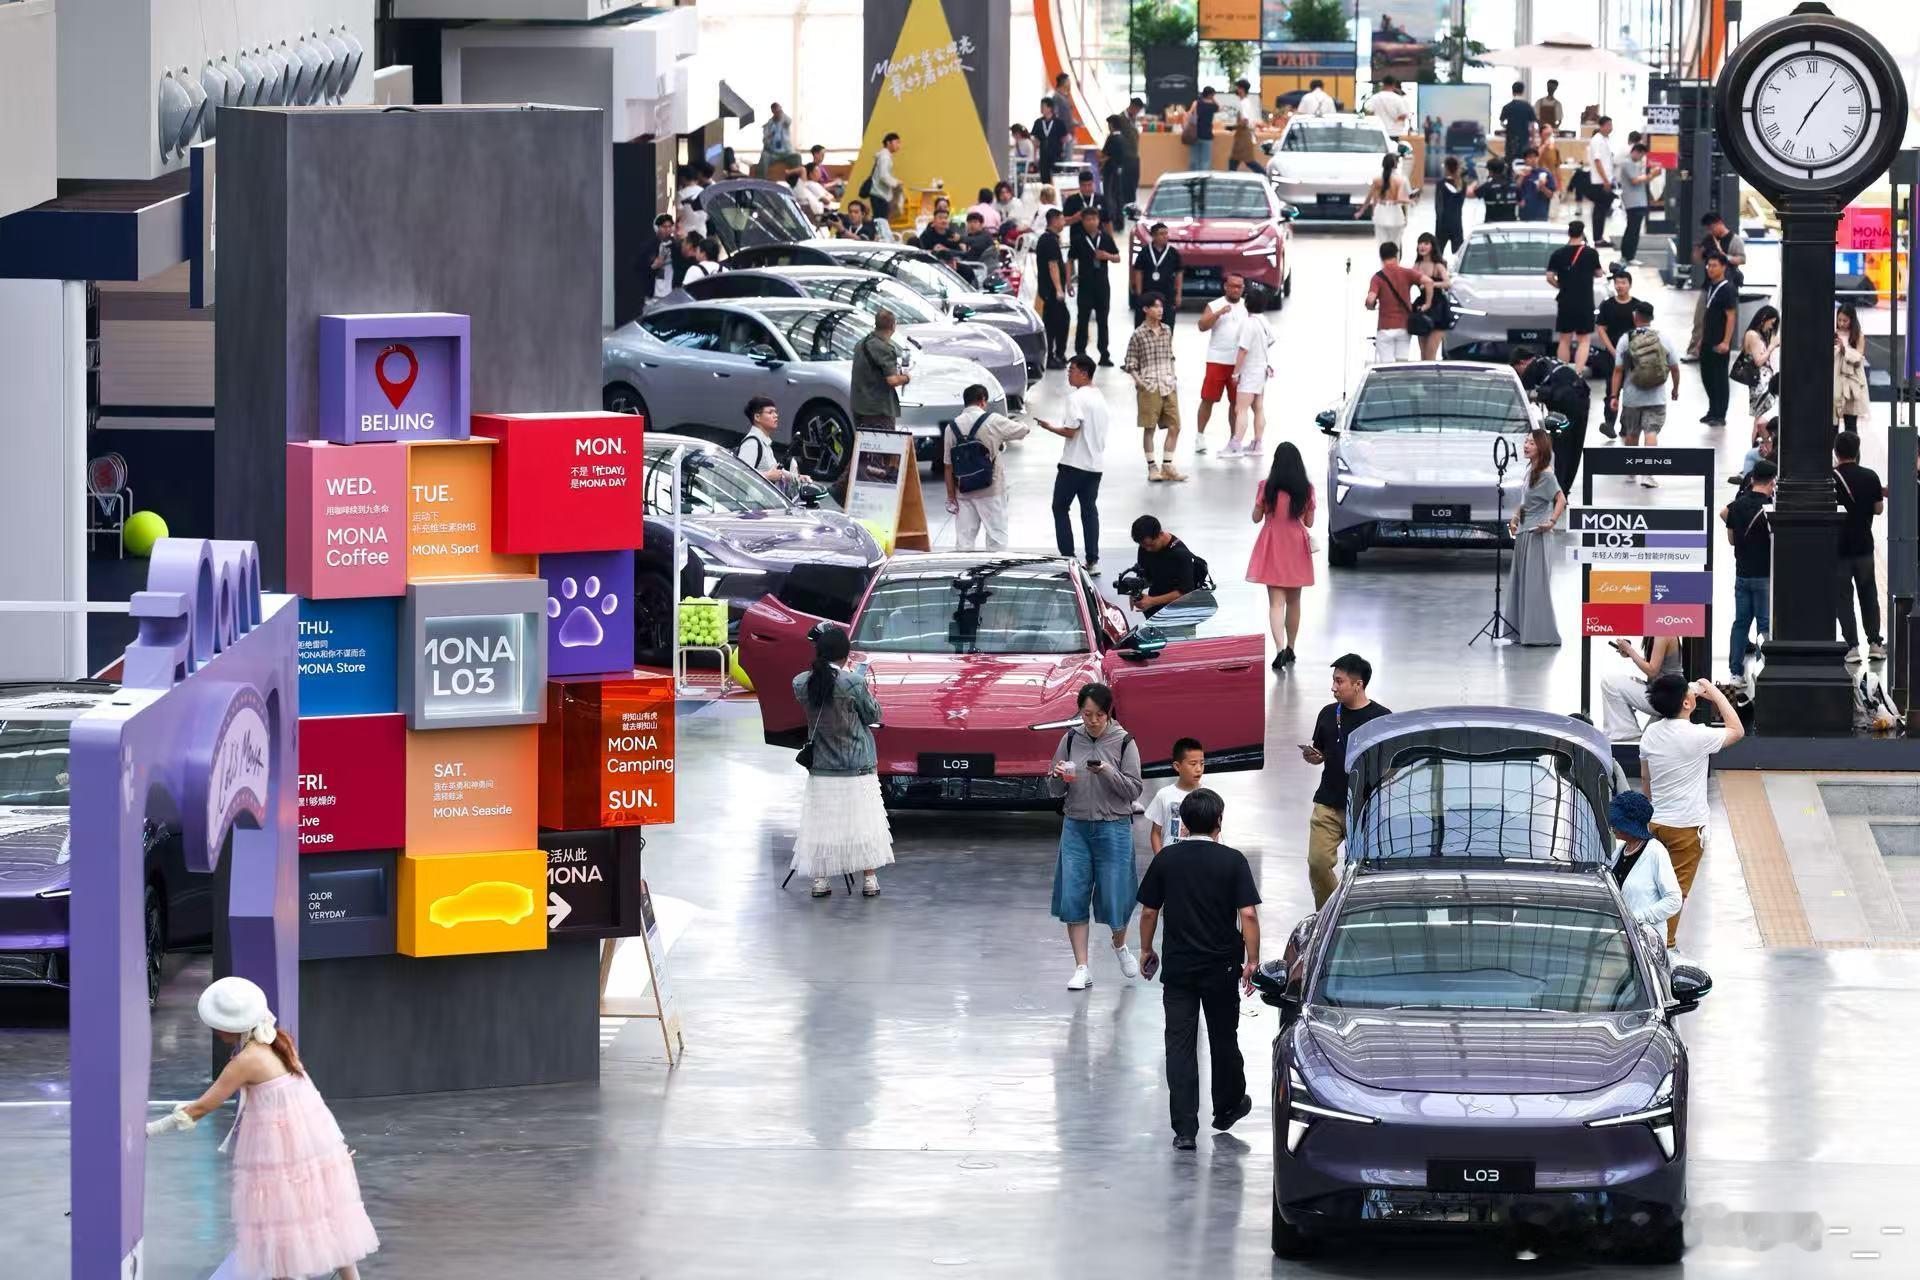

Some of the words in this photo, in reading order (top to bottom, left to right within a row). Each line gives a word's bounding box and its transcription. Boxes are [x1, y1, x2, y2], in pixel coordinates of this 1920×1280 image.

[1852, 226, 1890, 238] MONA
[1852, 239, 1876, 249] LIFE
[361, 413, 435, 432] BEIJING
[575, 437, 627, 456] MON.
[326, 477, 377, 496] WED.
[570, 478, 608, 489] 是MONA
[608, 477, 628, 487] DAY
[412, 484, 454, 503] TUE.
[1581, 513, 1649, 530] MONA
[327, 526, 388, 546] MONA
[326, 548, 390, 567] Coffee
[412, 544, 448, 556] MONA
[450, 543, 480, 557] Sport
[1591, 551, 1691, 560] 年轻人的第一台智能时尚SUV
[298, 620, 334, 636] THU.
[1586, 625, 1614, 633] MONA
[298, 663, 335, 675] MONA
[336, 662, 367, 674] Store
[608, 735, 659, 753] MONA
[434, 762, 468, 778] SAT.
[607, 755, 674, 775] Camping
[297, 773, 328, 791] FRI.
[608, 788, 659, 811] SUN.
[433, 806, 470, 819] MONA
[471, 804, 513, 817] Seaside
[308, 891, 333, 901] OLOR
